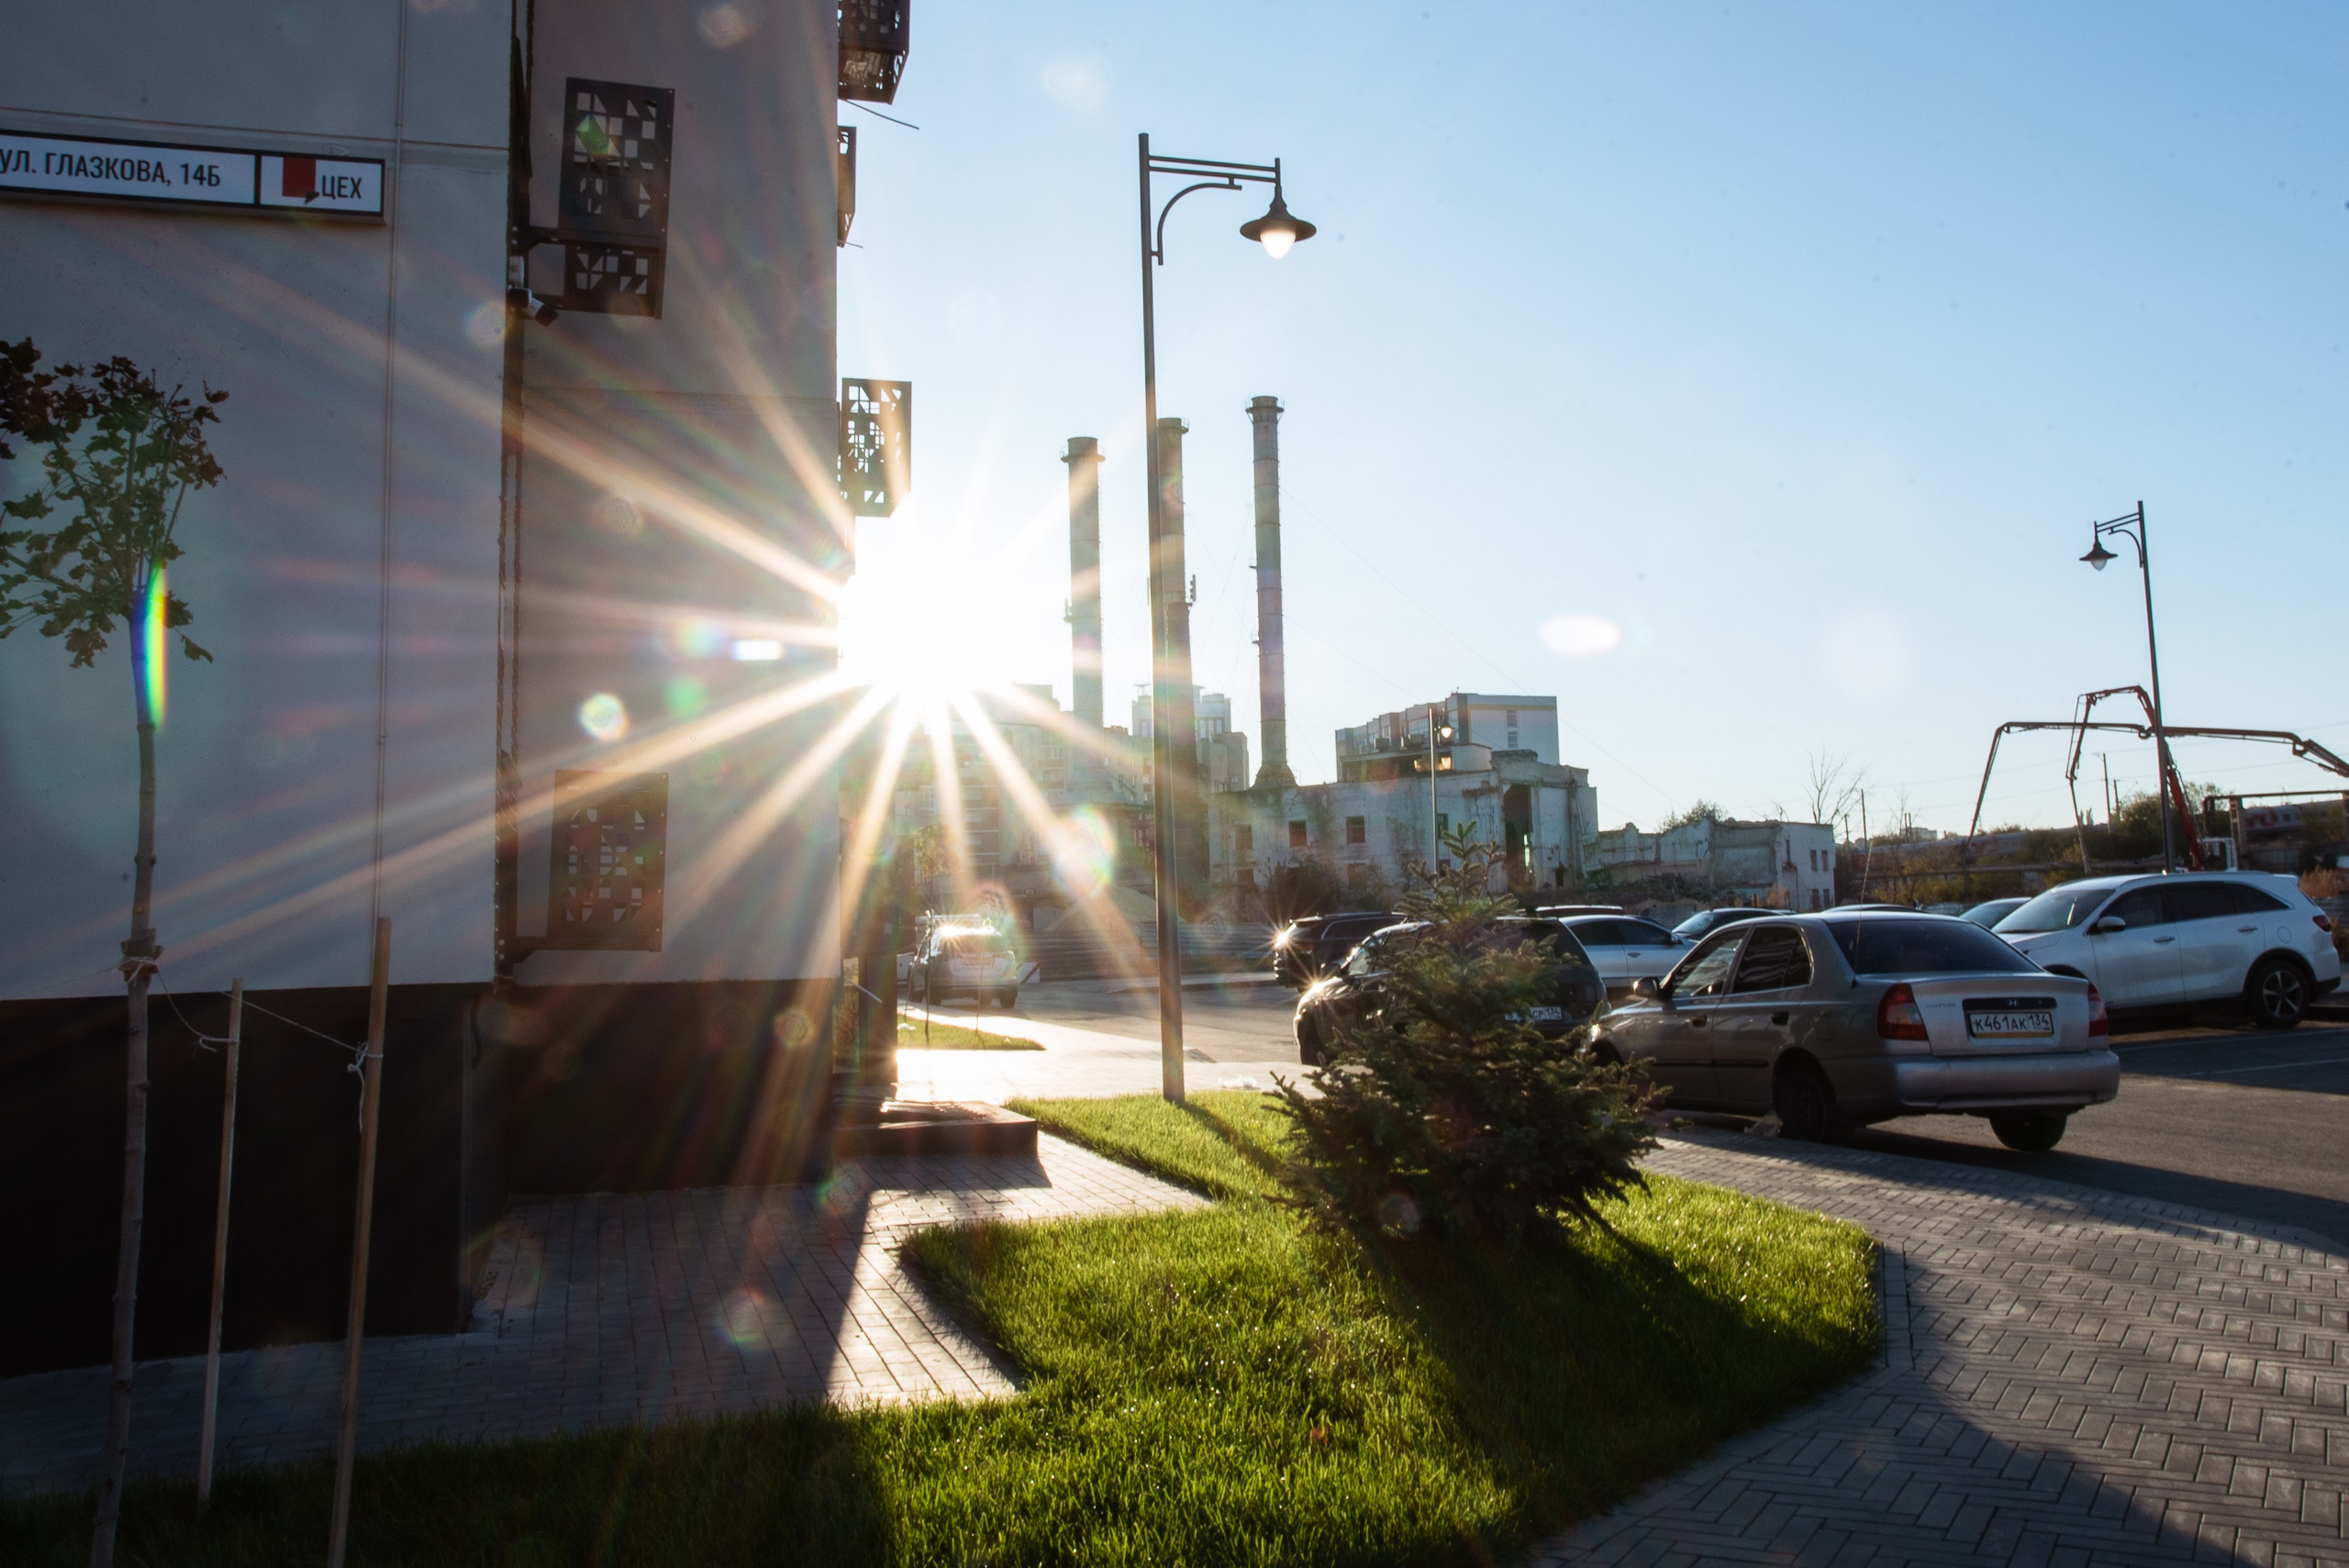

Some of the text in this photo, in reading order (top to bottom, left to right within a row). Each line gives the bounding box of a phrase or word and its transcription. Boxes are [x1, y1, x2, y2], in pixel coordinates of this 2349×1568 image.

[0, 148, 221, 186] УЛ. ГЛАЗКОВА, 14Б
[322, 175, 362, 199] ЦЕХ
[2029, 1014, 2049, 1026] 134
